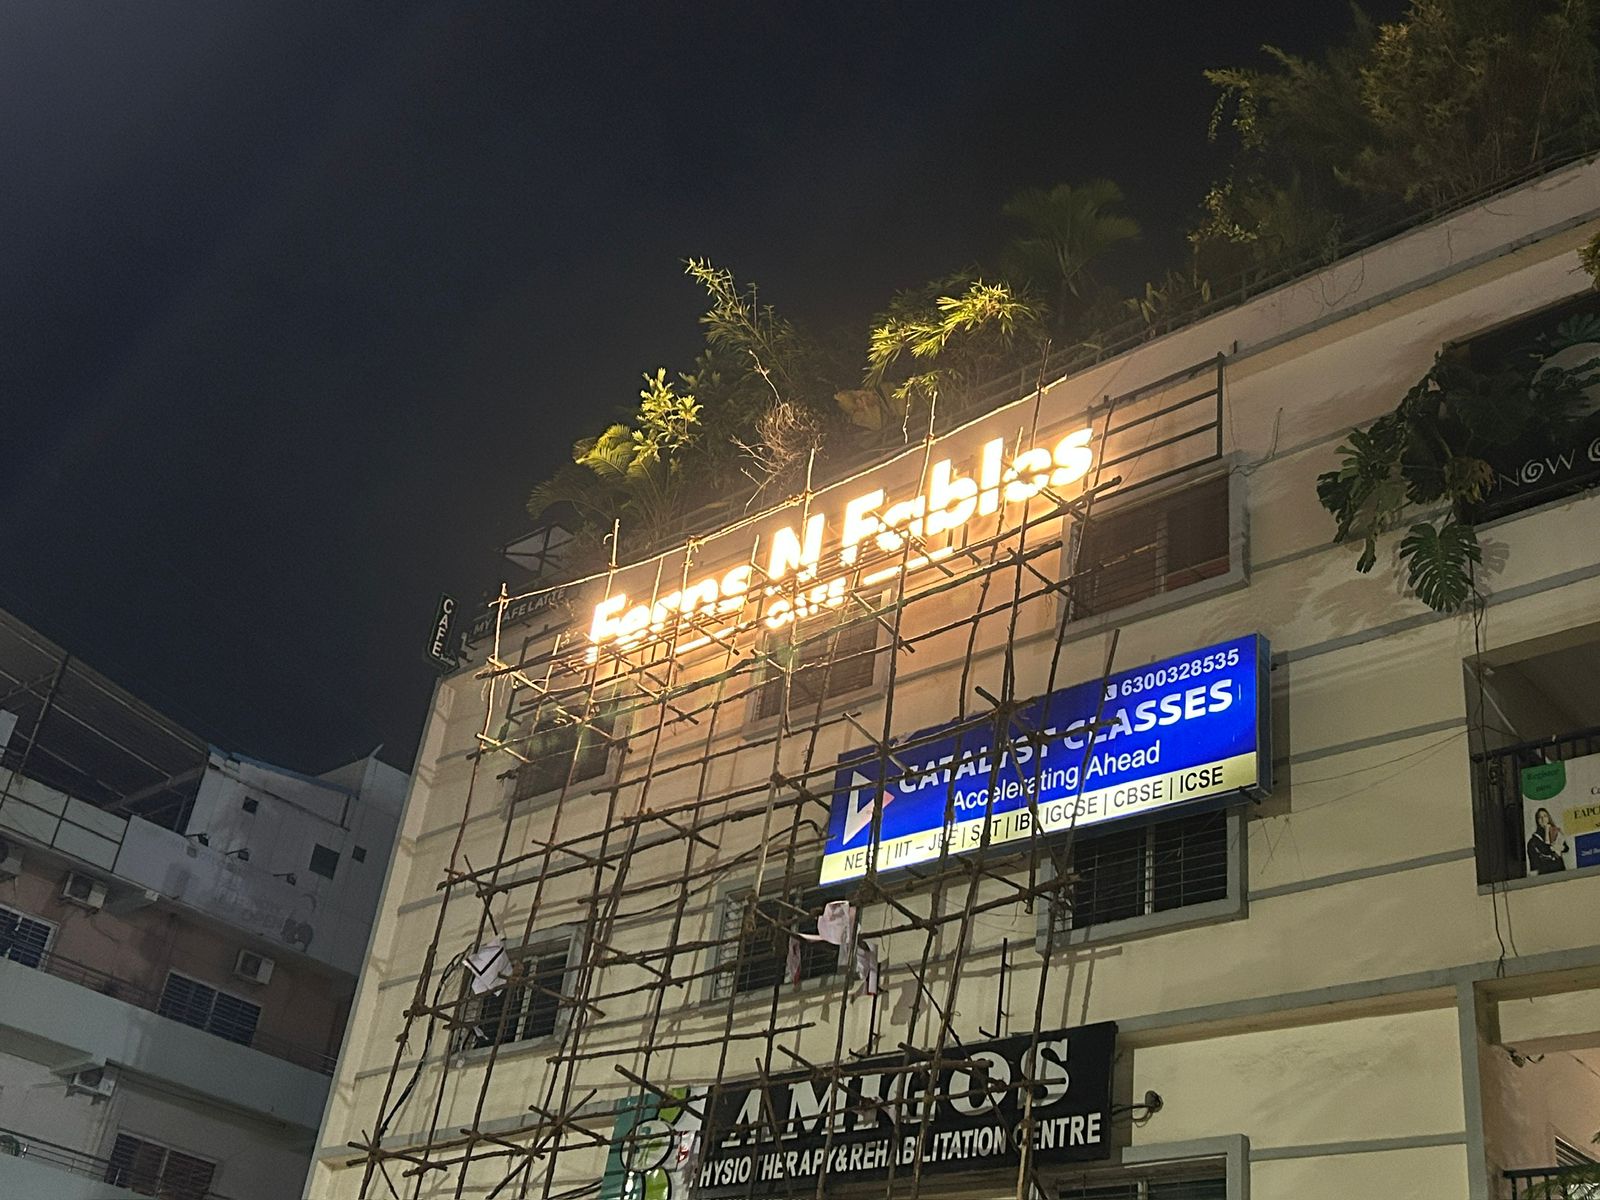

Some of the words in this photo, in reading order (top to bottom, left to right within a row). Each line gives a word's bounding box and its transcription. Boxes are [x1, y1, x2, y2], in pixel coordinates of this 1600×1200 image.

[432, 598, 454, 658] CAFE
[1121, 648, 1240, 696] 6300328535
[953, 765, 1079, 811] Accelerating
[1086, 740, 1161, 780] Ahead
[894, 839, 913, 860] IIT
[970, 819, 1001, 843] ST
[1014, 812, 1030, 831] IB
[1045, 795, 1098, 824] IGCSE
[1114, 780, 1163, 808] CBSE
[1179, 766, 1224, 794] ICSE
[721, 1038, 1070, 1149] AMIGOS
